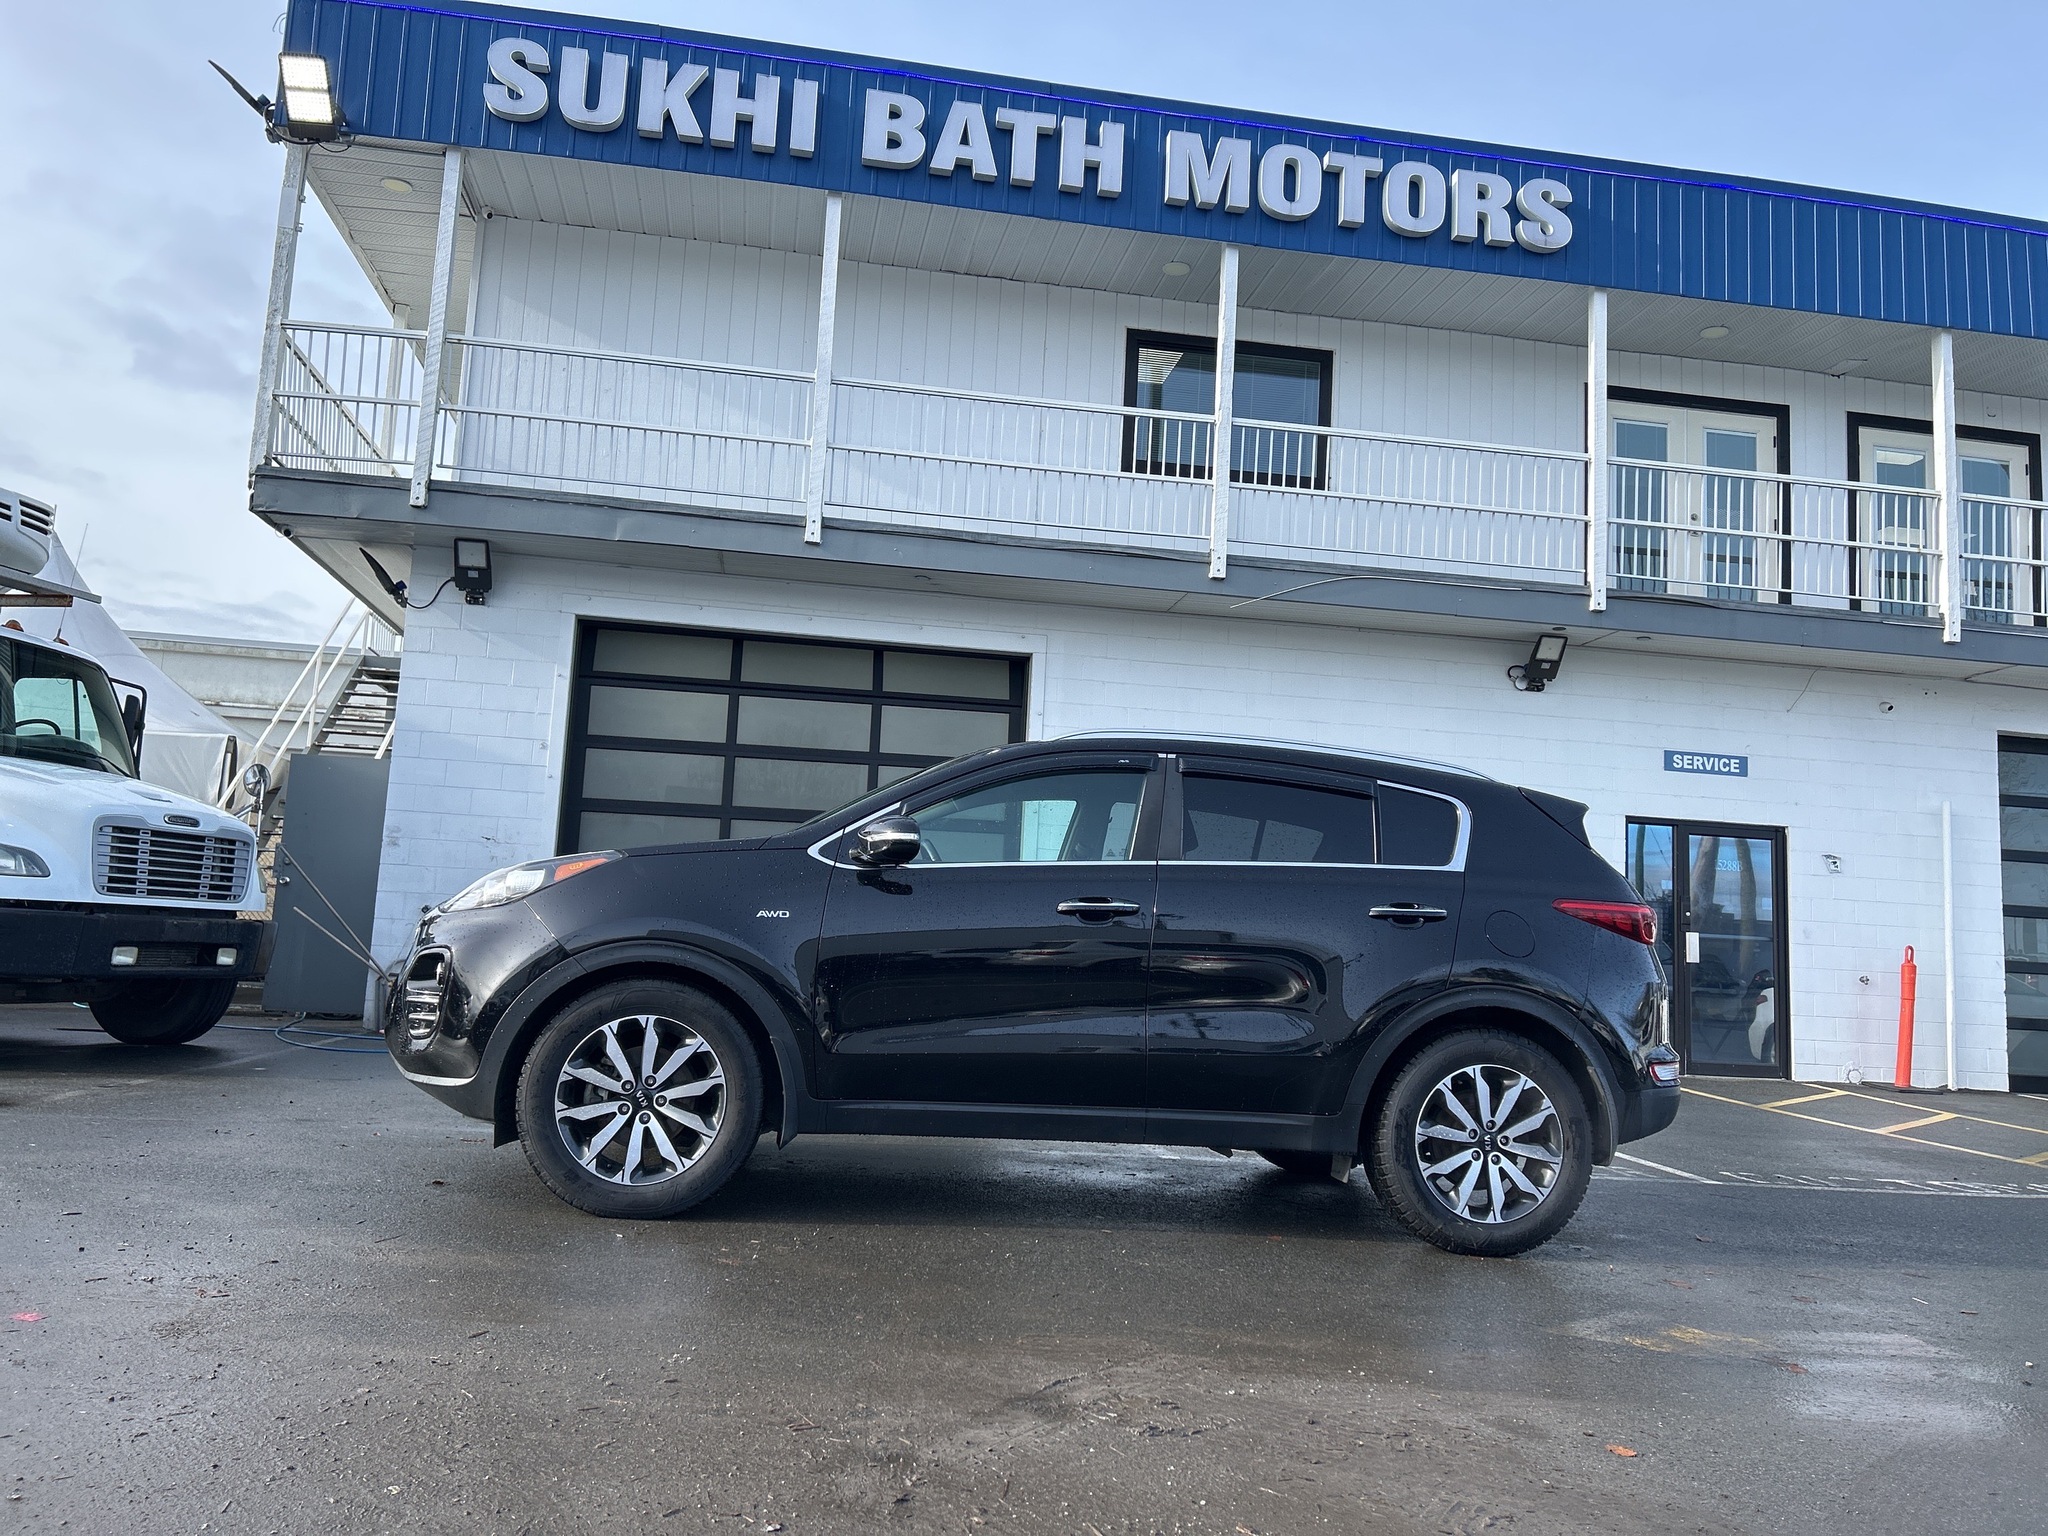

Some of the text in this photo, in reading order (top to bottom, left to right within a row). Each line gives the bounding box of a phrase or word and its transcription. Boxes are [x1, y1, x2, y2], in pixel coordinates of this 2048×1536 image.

[483, 37, 1573, 254] SUKHI BATH MOTORS
[1672, 754, 1740, 773] SERVICE
[755, 910, 790, 918] AWD
[635, 1090, 649, 1108] KIA
[1484, 1134, 1492, 1151] KIA
